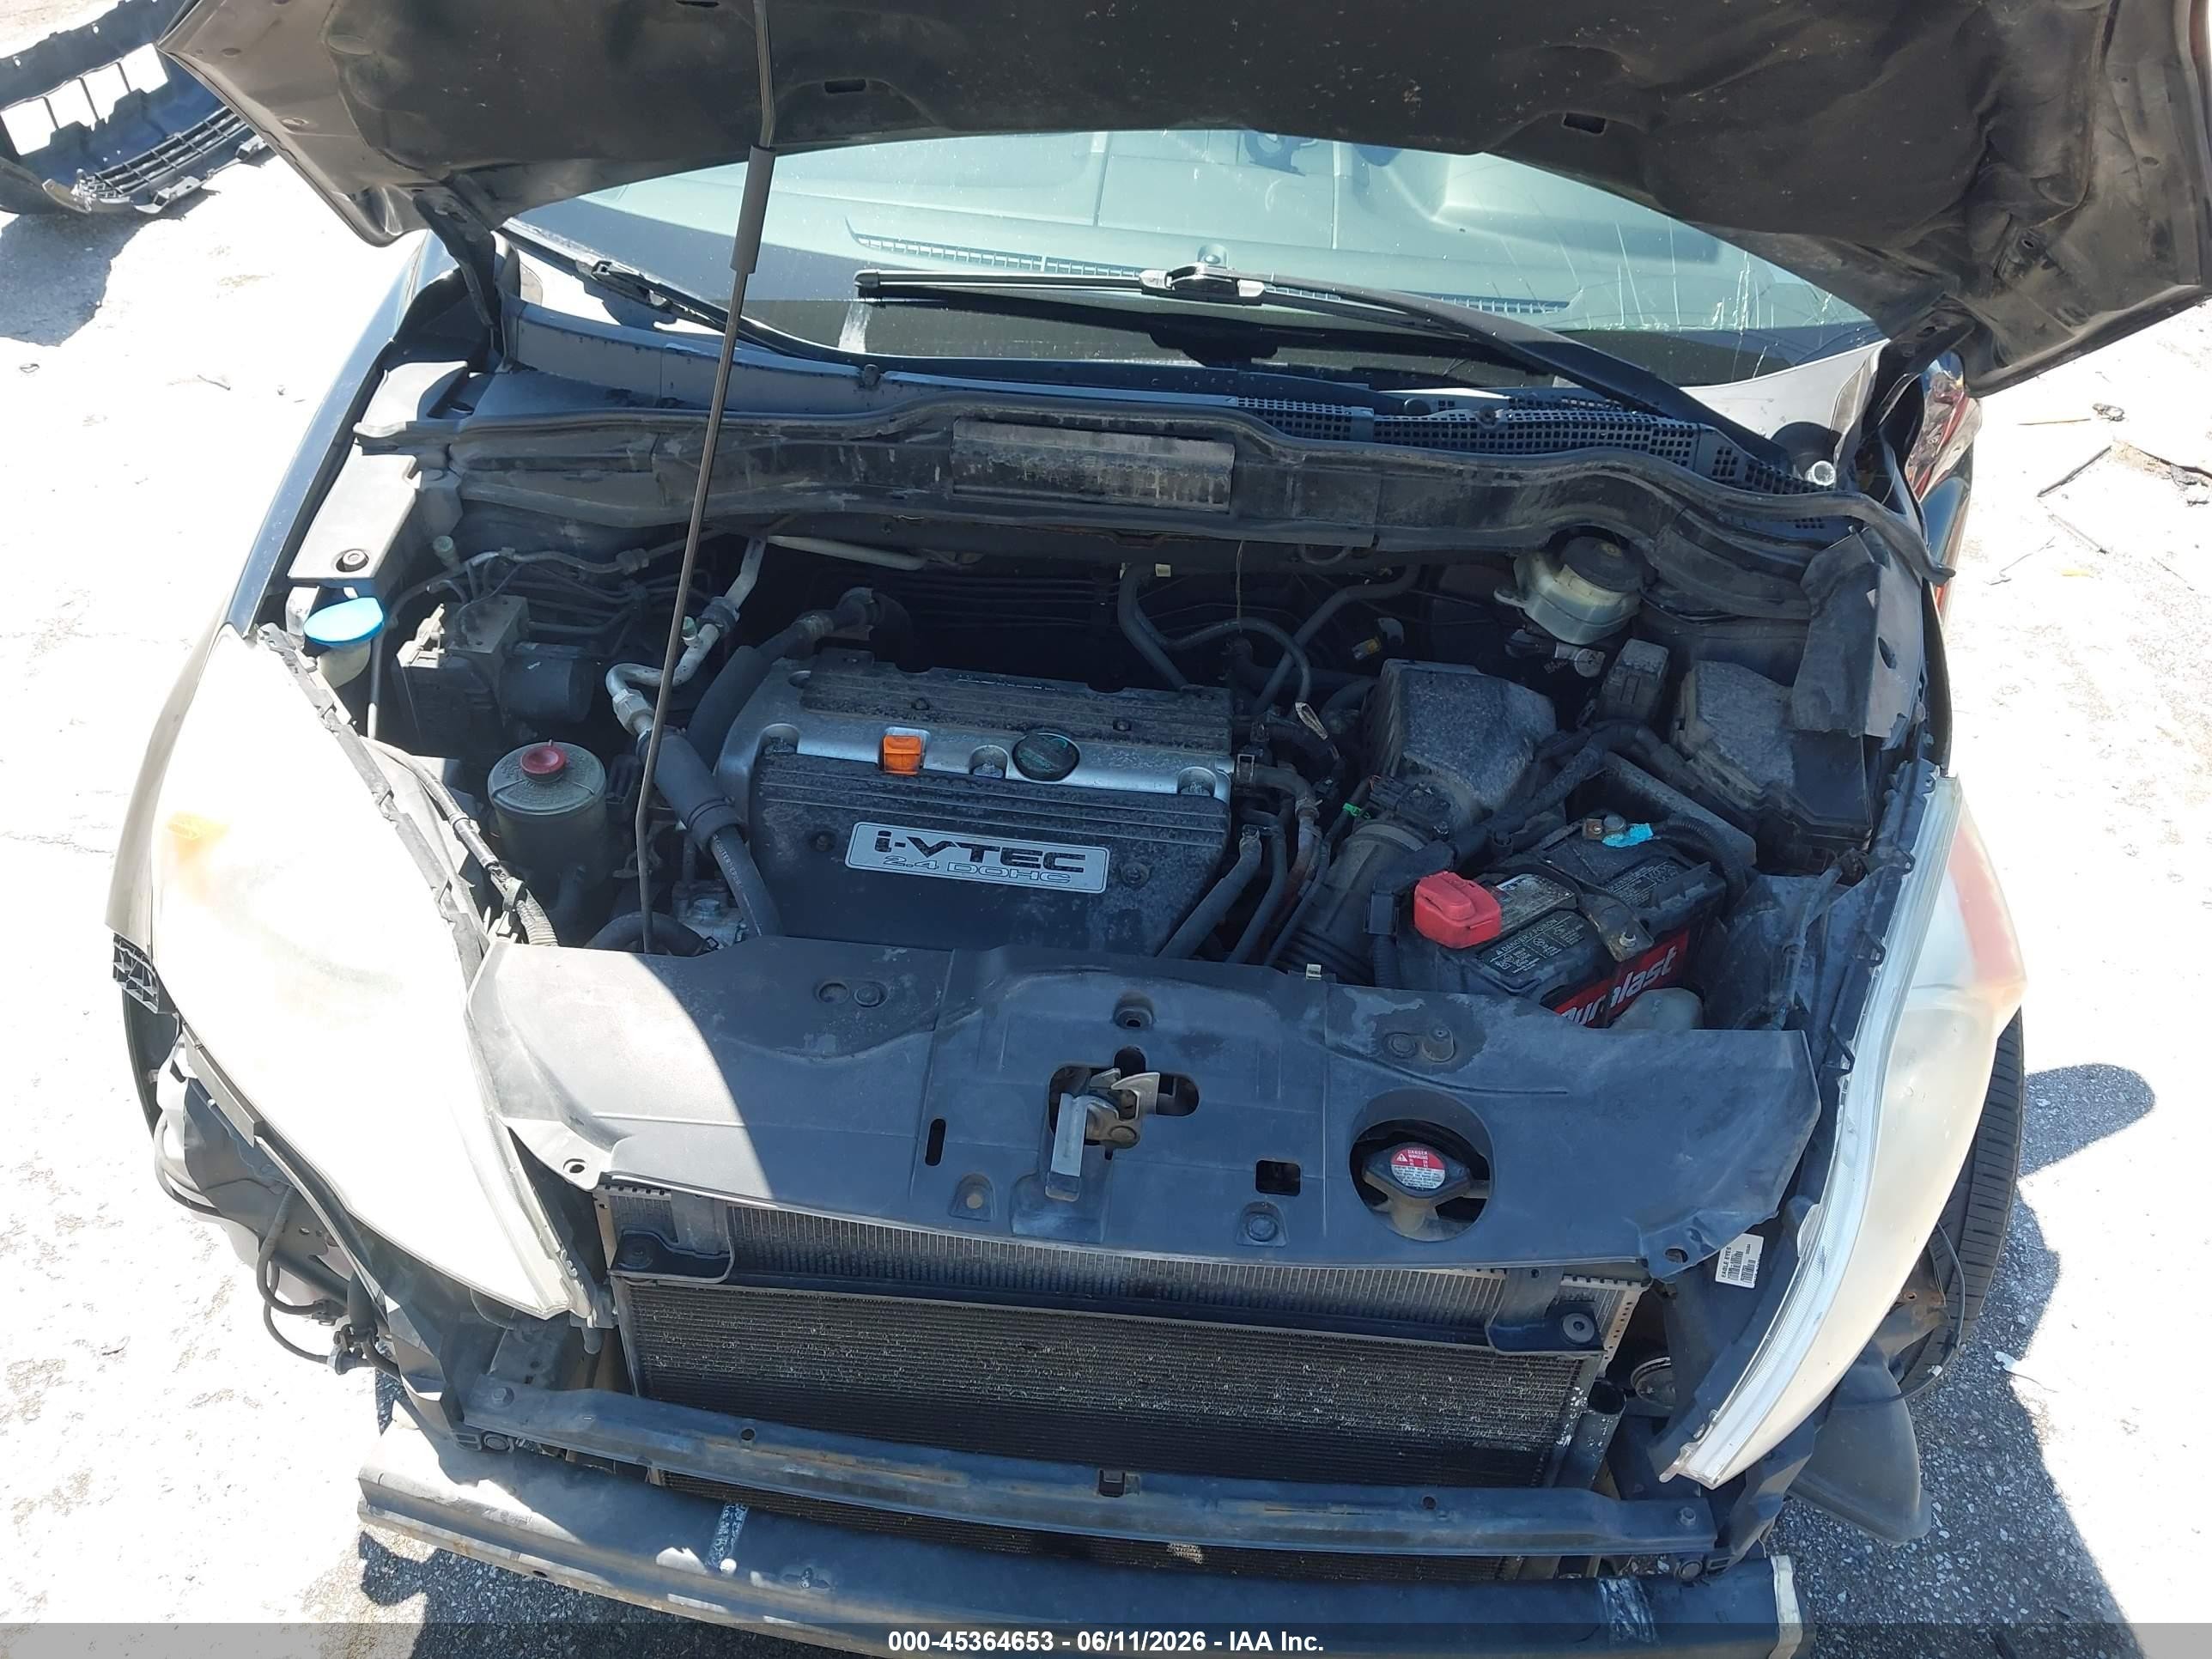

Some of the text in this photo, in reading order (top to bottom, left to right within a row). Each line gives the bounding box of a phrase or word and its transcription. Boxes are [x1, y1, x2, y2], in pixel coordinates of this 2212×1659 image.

[874, 830, 1087, 873] i-VTEC
[882, 854, 1072, 884] 2.4 DOHC
